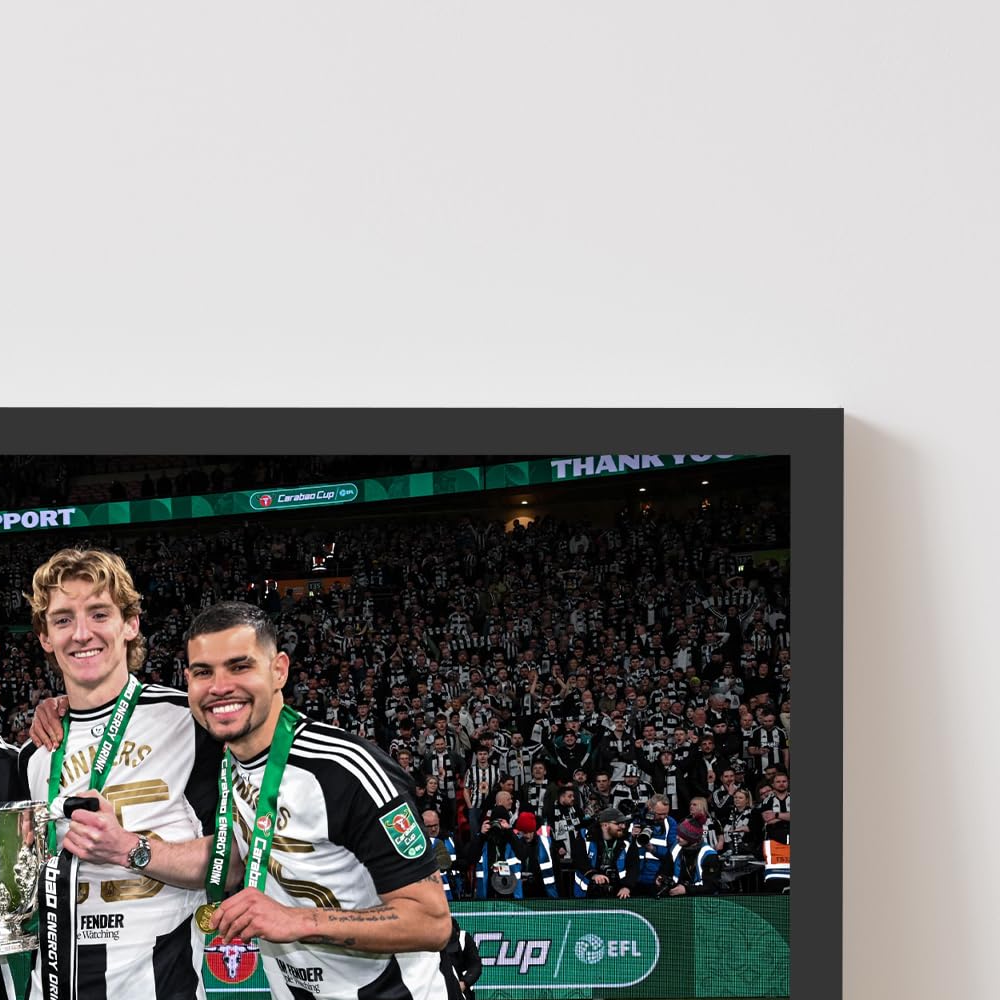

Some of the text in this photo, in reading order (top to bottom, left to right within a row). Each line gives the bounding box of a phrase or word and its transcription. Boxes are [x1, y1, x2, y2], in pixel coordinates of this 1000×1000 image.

[94, 699, 129, 775] ENERGY DRINK
[209, 759, 231, 886] Carabao ENERGY DRINK
[46, 911, 58, 972] ENERGY
[80, 913, 125, 931] FENDER
[82, 929, 120, 942] Watching
[473, 931, 642, 974] Cup EFL
